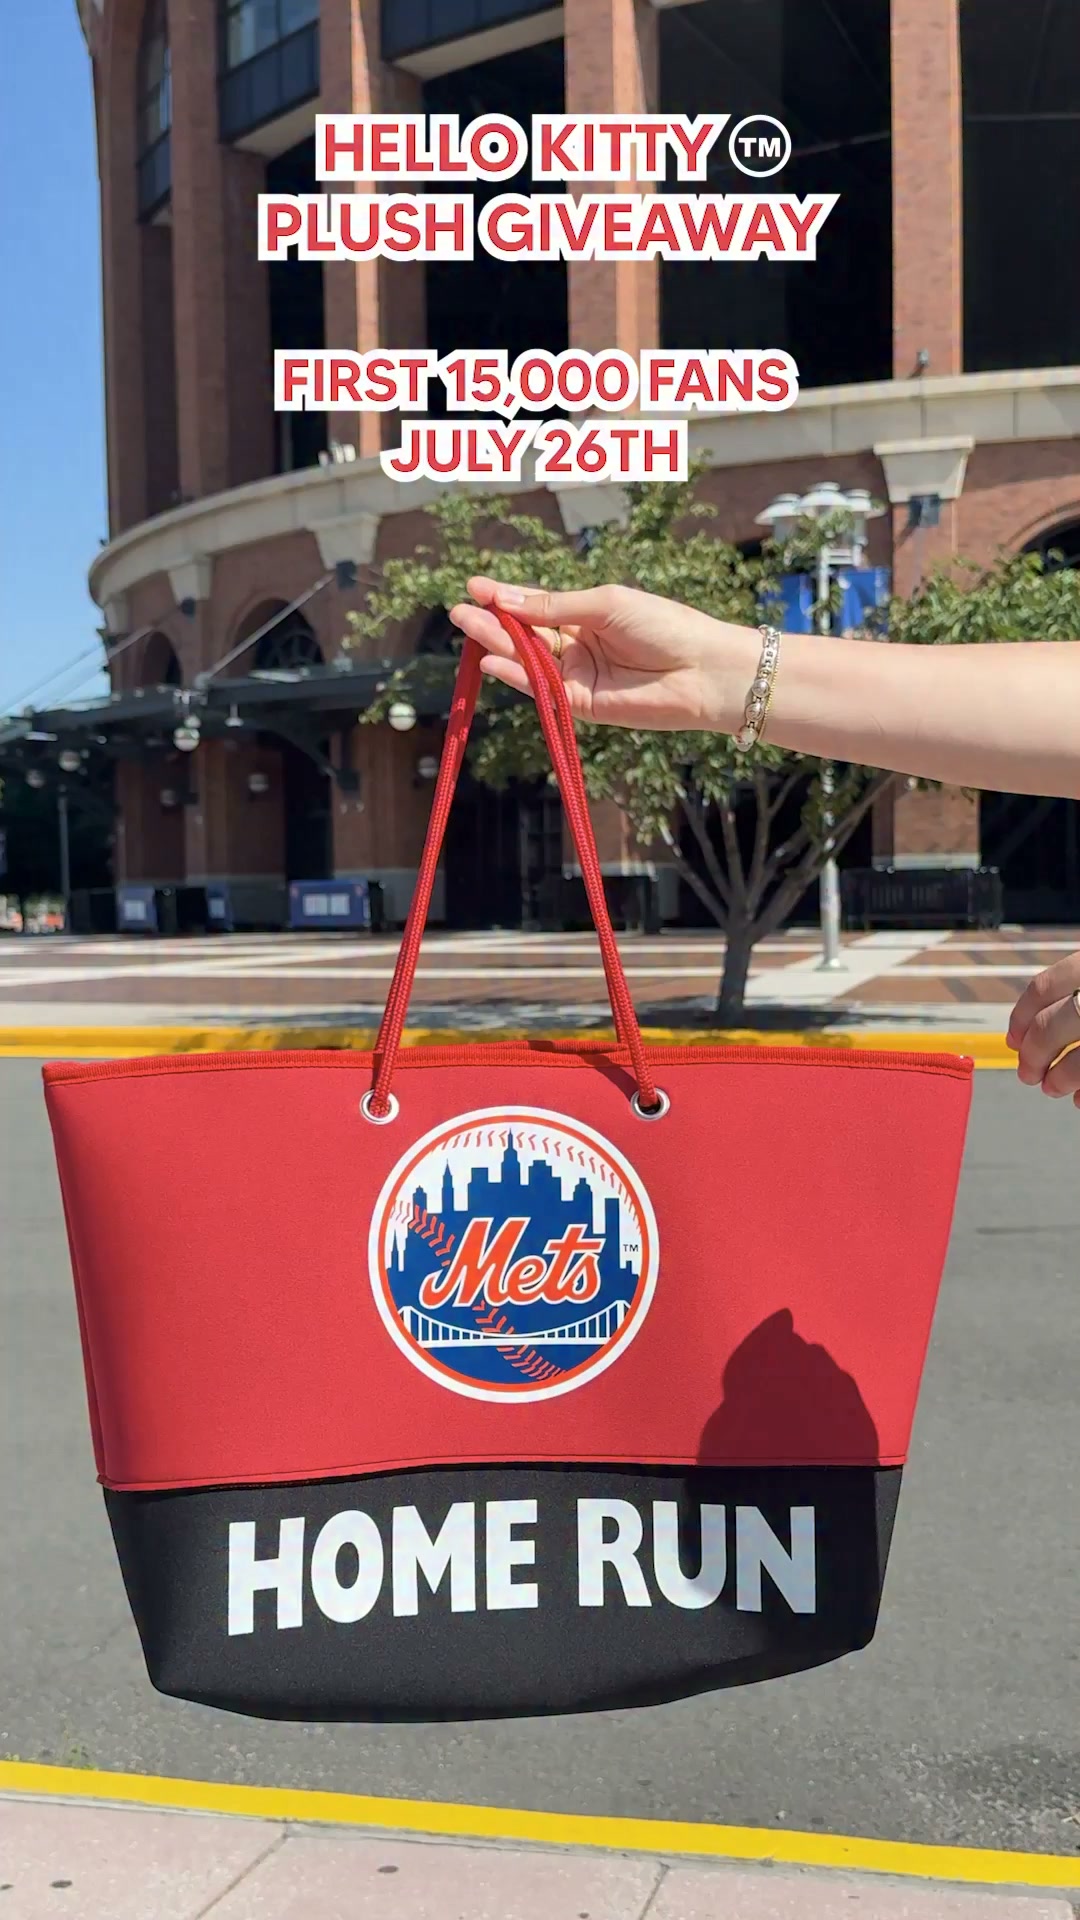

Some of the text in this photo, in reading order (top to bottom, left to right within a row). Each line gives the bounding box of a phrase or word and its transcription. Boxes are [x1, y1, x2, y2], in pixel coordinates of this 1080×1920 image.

[419, 1216, 606, 1309] Mets
[227, 1497, 817, 1637] HOME RUN
